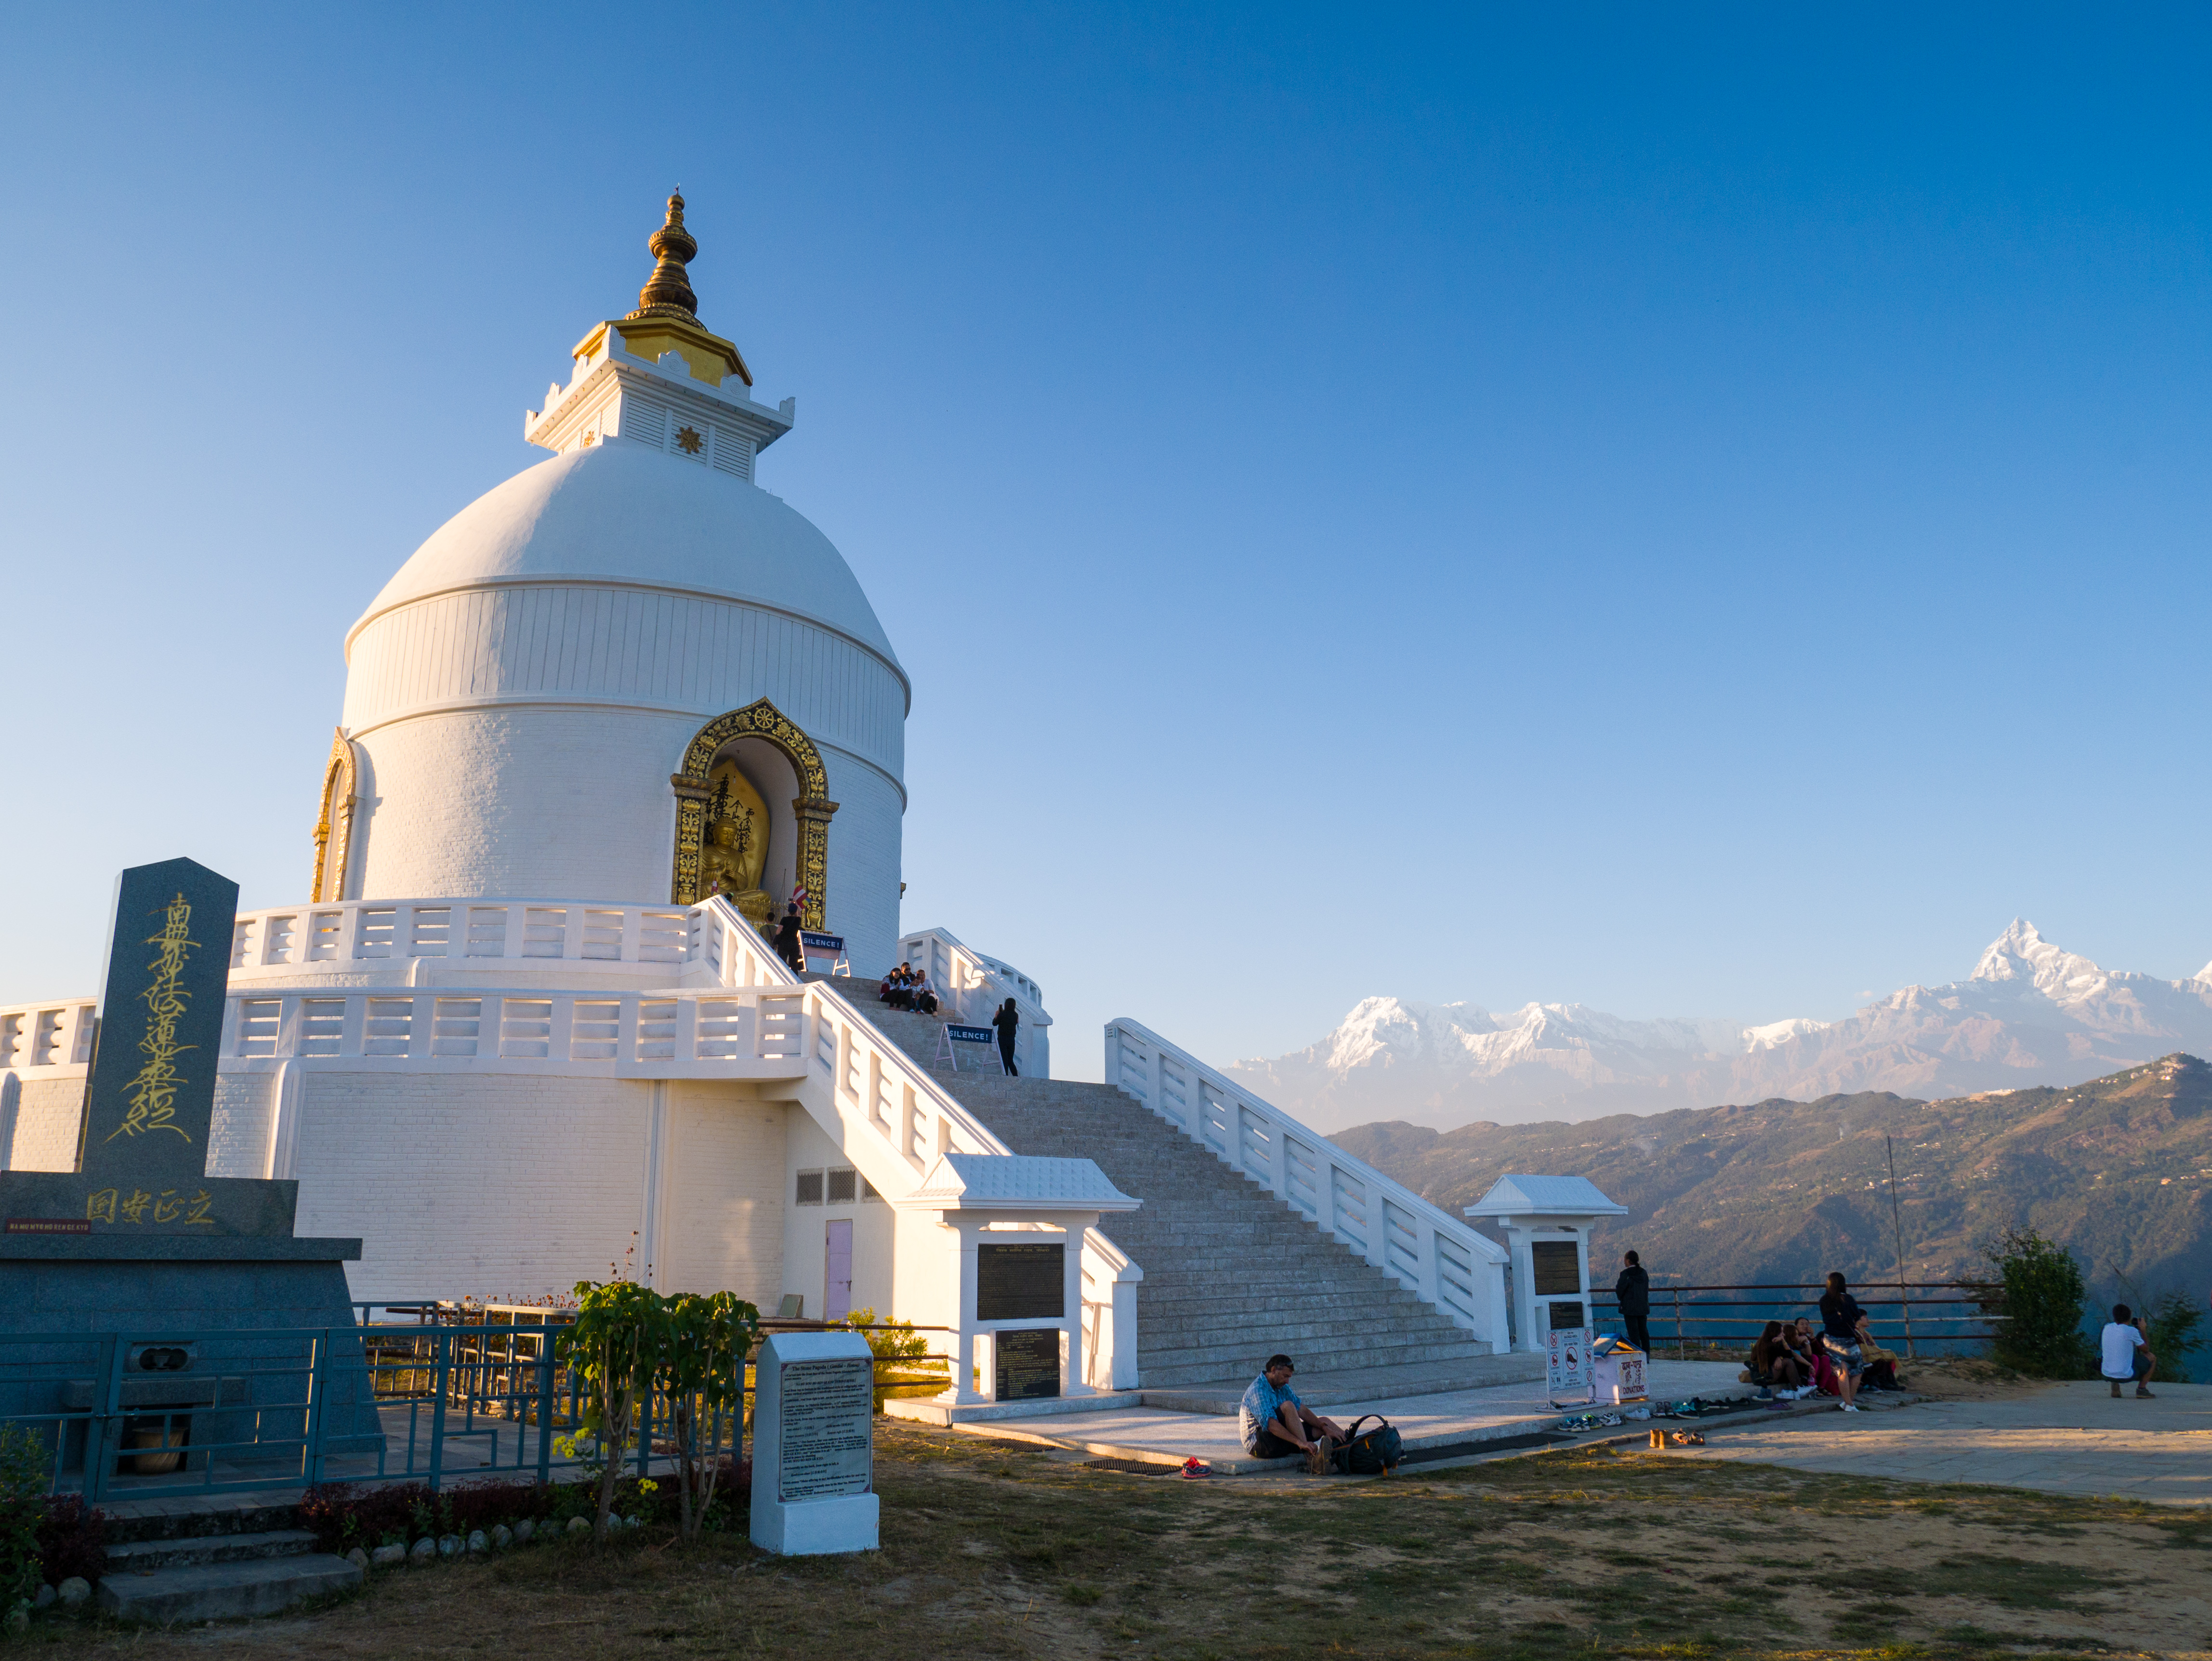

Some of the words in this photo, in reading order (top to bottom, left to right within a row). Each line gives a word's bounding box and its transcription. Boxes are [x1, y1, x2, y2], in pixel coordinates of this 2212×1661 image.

[803, 938, 839, 948] SILENCE!
[949, 1030, 988, 1041] SILENCE!
[1623, 1385, 1645, 1394] DONATIONS
